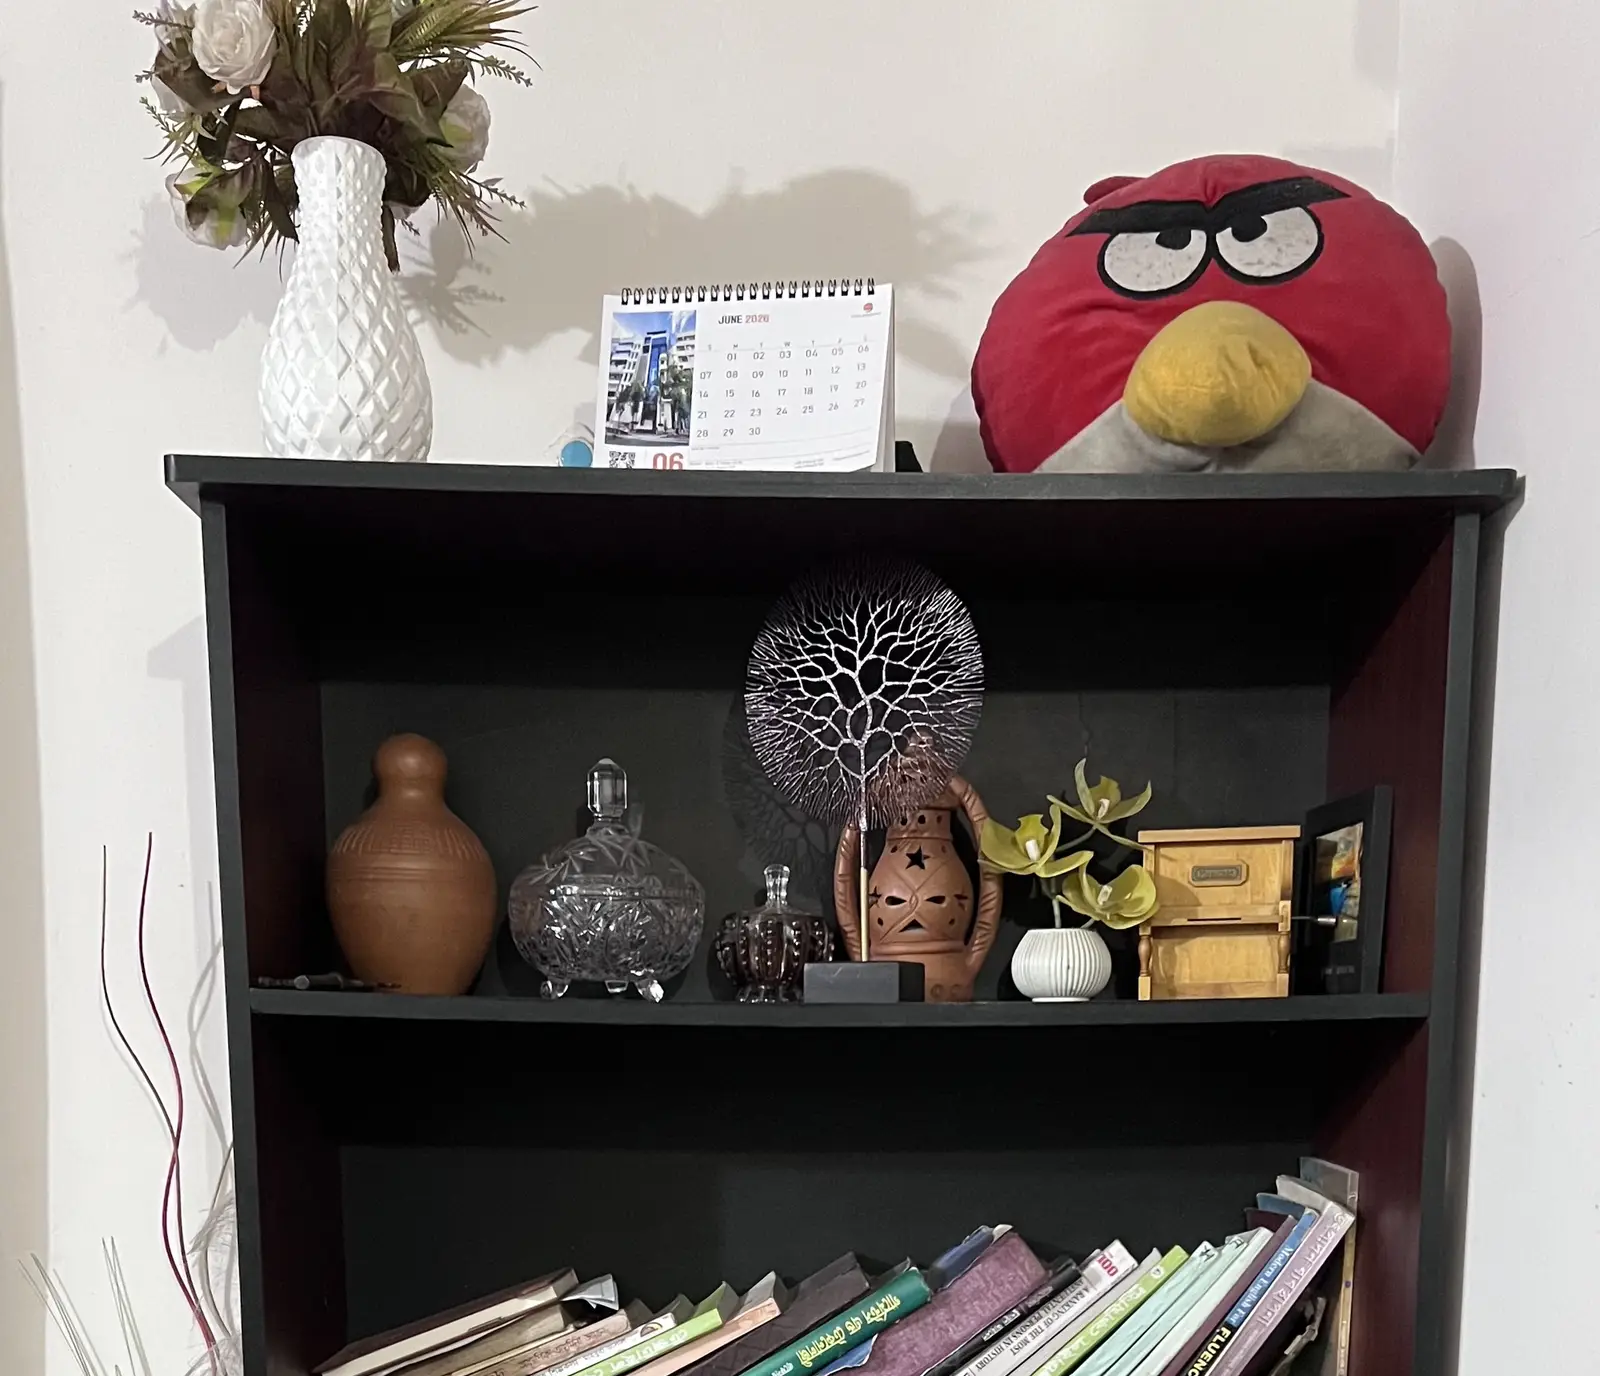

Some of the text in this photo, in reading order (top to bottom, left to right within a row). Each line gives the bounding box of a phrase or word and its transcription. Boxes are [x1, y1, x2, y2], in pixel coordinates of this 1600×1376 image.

[718, 315, 743, 325] JUNE
[727, 353, 737, 361] 01
[753, 352, 764, 360] 02
[779, 351, 791, 359] 03
[805, 350, 818, 358] 04
[700, 371, 711, 380] 07
[726, 370, 738, 378] 08
[752, 370, 764, 378] 09
[779, 369, 788, 378] 10
[805, 368, 812, 376] 11
[700, 390, 708, 398] 14
[725, 389, 734, 398] 15
[751, 389, 760, 397] 16
[778, 389, 786, 397] 17
[804, 387, 813, 395] 18
[698, 411, 707, 419] 21
[724, 410, 735, 418] 22
[750, 408, 761, 417] 23
[776, 407, 787, 416] 24
[802, 405, 814, 414] 25
[697, 427, 761, 438] 28 29 30
[652, 453, 684, 472] 06
[1097, 1252, 1120, 1278] 100
[1260, 1241, 1294, 1283] Modern
[1238, 1277, 1267, 1311] English
[859, 1290, 905, 1329] গার্মেন্টস
[1050, 1289, 1084, 1320] RANKING
[1009, 1310, 1043, 1341] PERSONS
[1040, 1315, 1054, 1329] OF
[1227, 1306, 1246, 1327] For
[1027, 1324, 1044, 1340] THE
[1000, 1335, 1014, 1349] IN
[1008, 1335, 1031, 1356] MOST
[972, 1342, 1005, 1372] HISTORY
